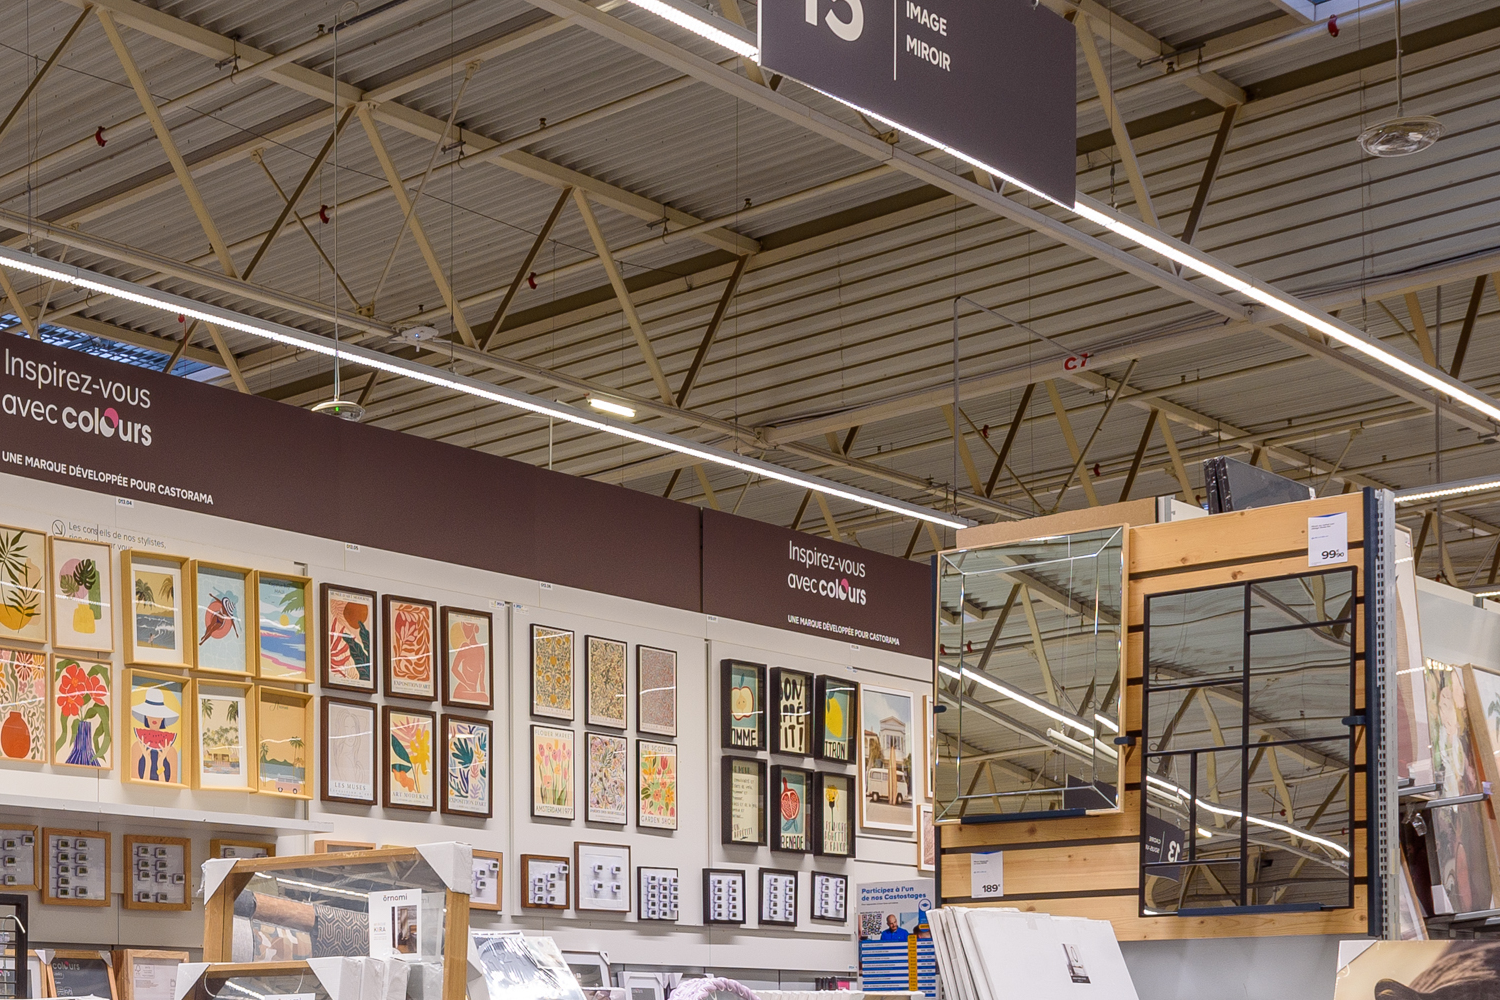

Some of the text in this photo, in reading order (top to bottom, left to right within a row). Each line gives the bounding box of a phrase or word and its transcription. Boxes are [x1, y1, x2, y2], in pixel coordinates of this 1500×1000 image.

[906, 0, 948, 37] IMAGE
[906, 34, 951, 72] MIROIR
[4, 348, 151, 409] Inspirez-vous
[2, 393, 152, 447] avec colours
[2, 451, 214, 505] UNE MARQUE DÉVELOPPÉE POUR CASTORAMA
[68, 522, 81, 532] Les
[113, 529, 122, 540] de
[123, 534, 136, 543] nos
[789, 540, 866, 578] Inspirez-vous
[787, 572, 867, 606] avec colours
[787, 614, 800, 625] UNE
[800, 616, 823, 630] MARQUE
[854, 629, 869, 640] POUR
[869, 632, 900, 646] CASTORAMA
[780, 678, 803, 701] ON
[780, 702, 804, 725] PPÉ
[731, 728, 756, 748] OMME
[780, 725, 804, 751] IT!
[781, 835, 804, 850] RENADE
[861, 887, 894, 895] Participez
[884, 893, 927, 901] Castostages
[52, 961, 80, 971] colours
